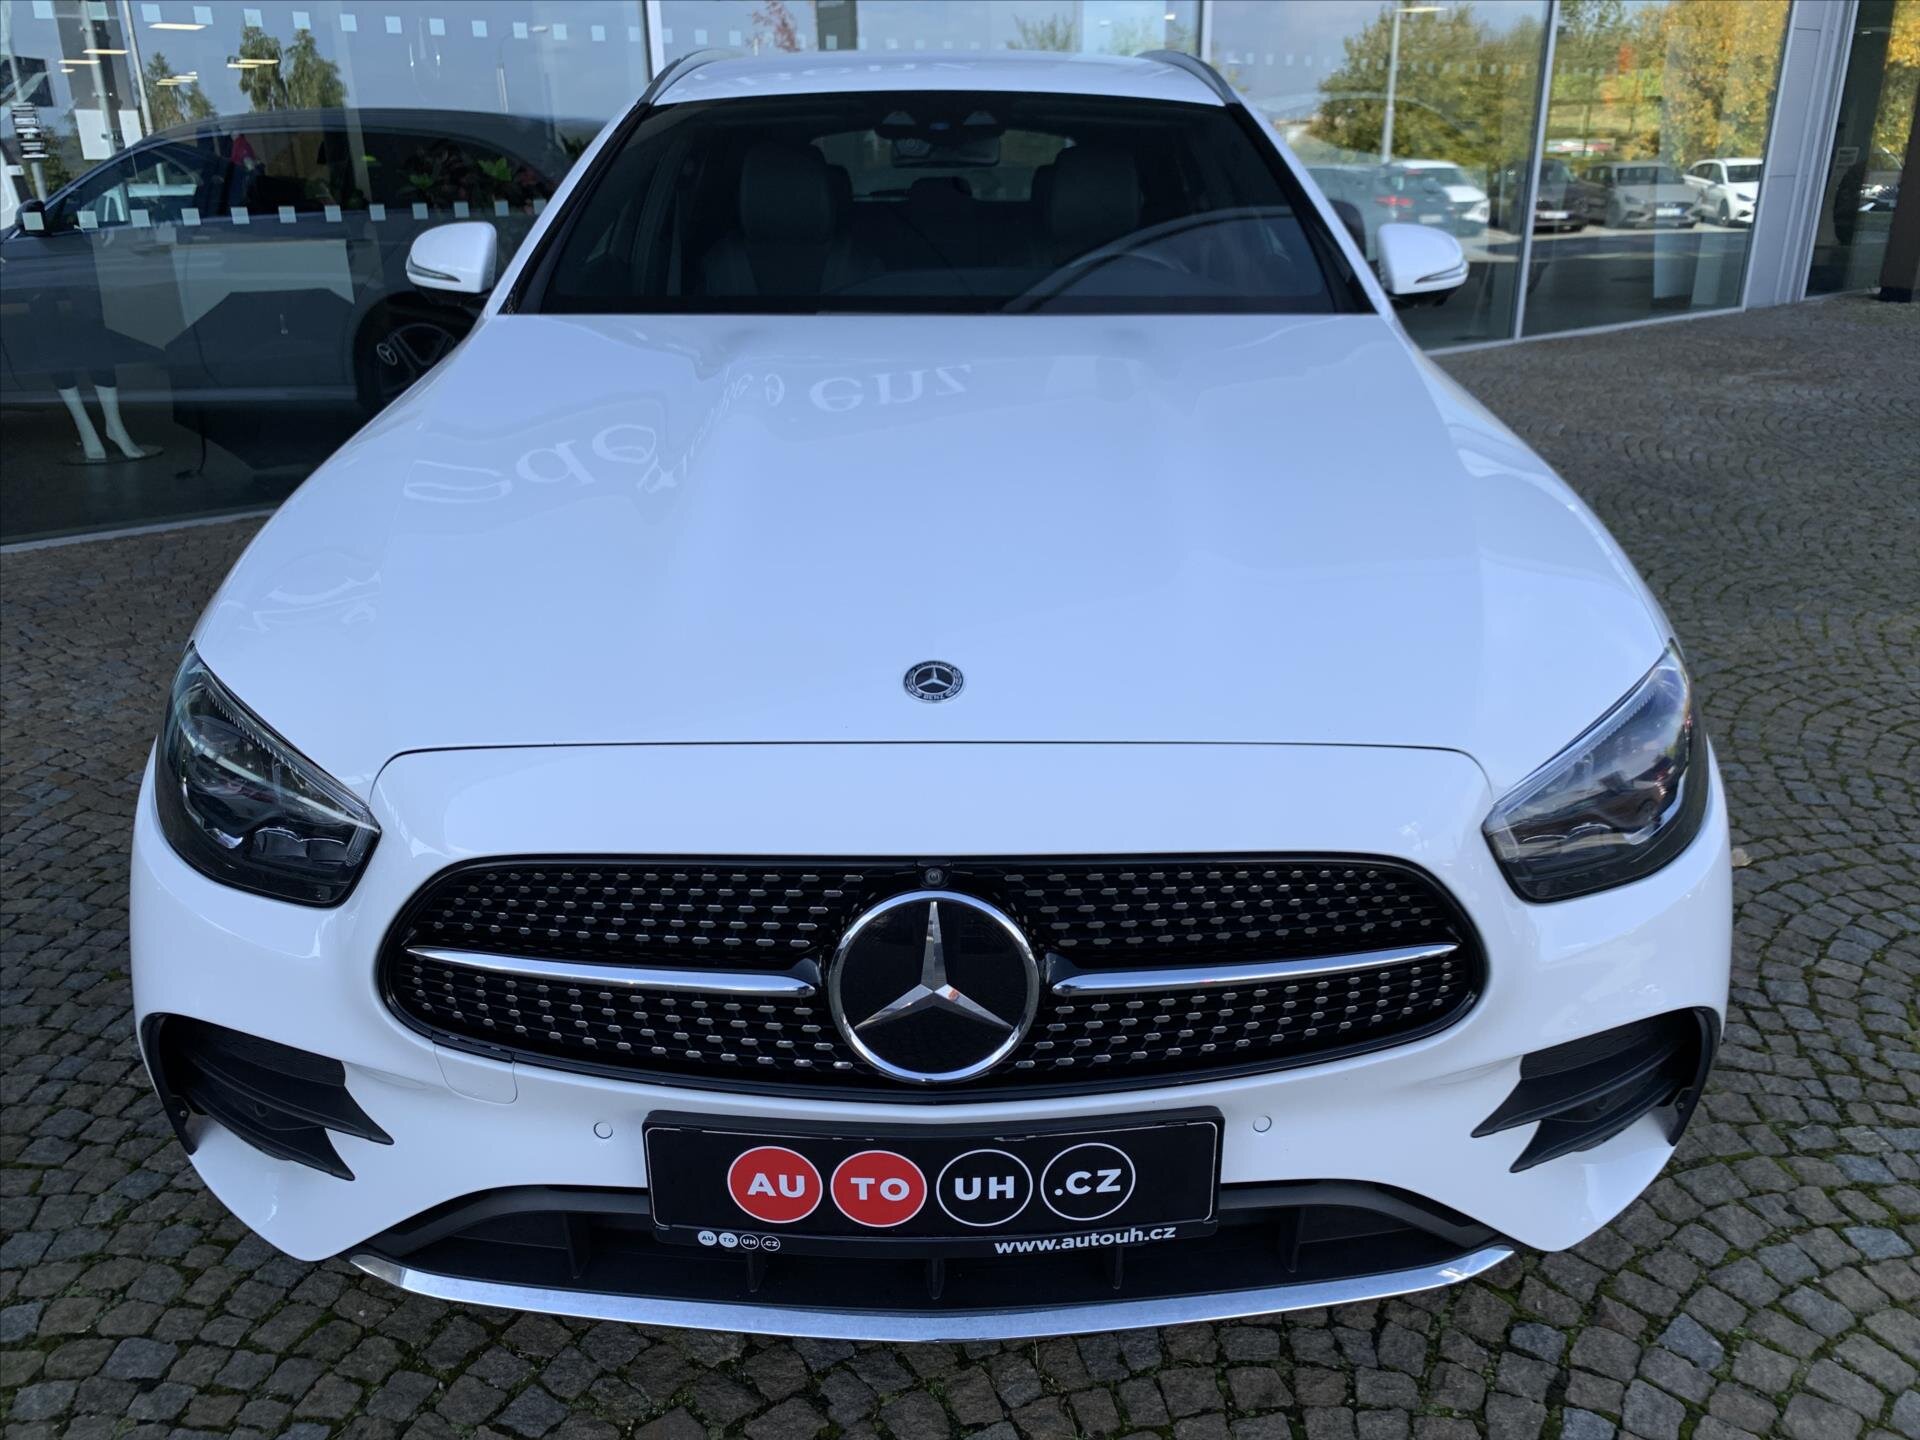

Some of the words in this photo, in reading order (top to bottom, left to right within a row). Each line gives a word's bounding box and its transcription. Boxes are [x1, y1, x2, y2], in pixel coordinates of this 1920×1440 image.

[747, 1172, 806, 1199] AU
[850, 1177, 910, 1202] TO
[954, 1175, 1015, 1201] UH
[1054, 1168, 1122, 1197] .CZ
[994, 1226, 1177, 1254] www.autouh.cz
